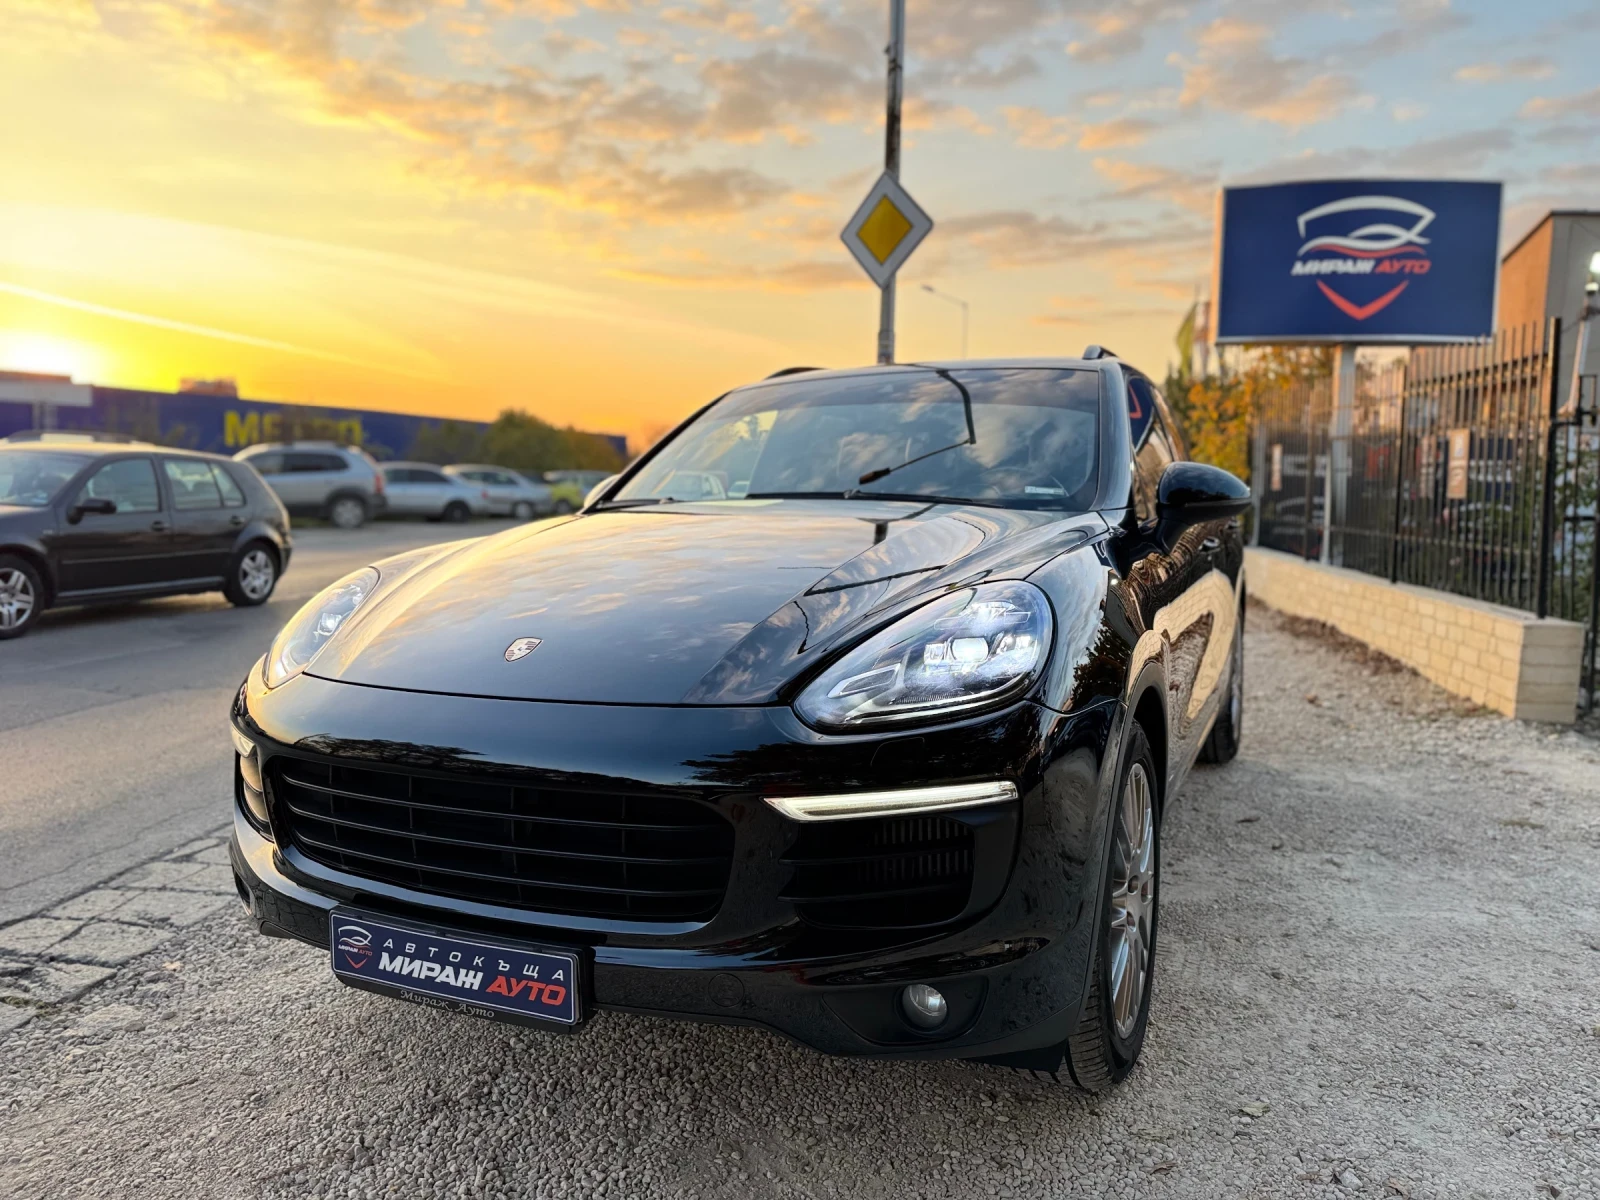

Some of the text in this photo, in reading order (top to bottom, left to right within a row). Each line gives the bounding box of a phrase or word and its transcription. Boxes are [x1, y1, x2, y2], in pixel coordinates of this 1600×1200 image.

[1376, 260, 1431, 273] АУТО
[224, 411, 363, 447] MEO
[384, 938, 564, 981] АВТОКЪЩА
[378, 952, 567, 1005] МИРАЖ АУТО
[401, 990, 495, 1018] Мираж Ауто
